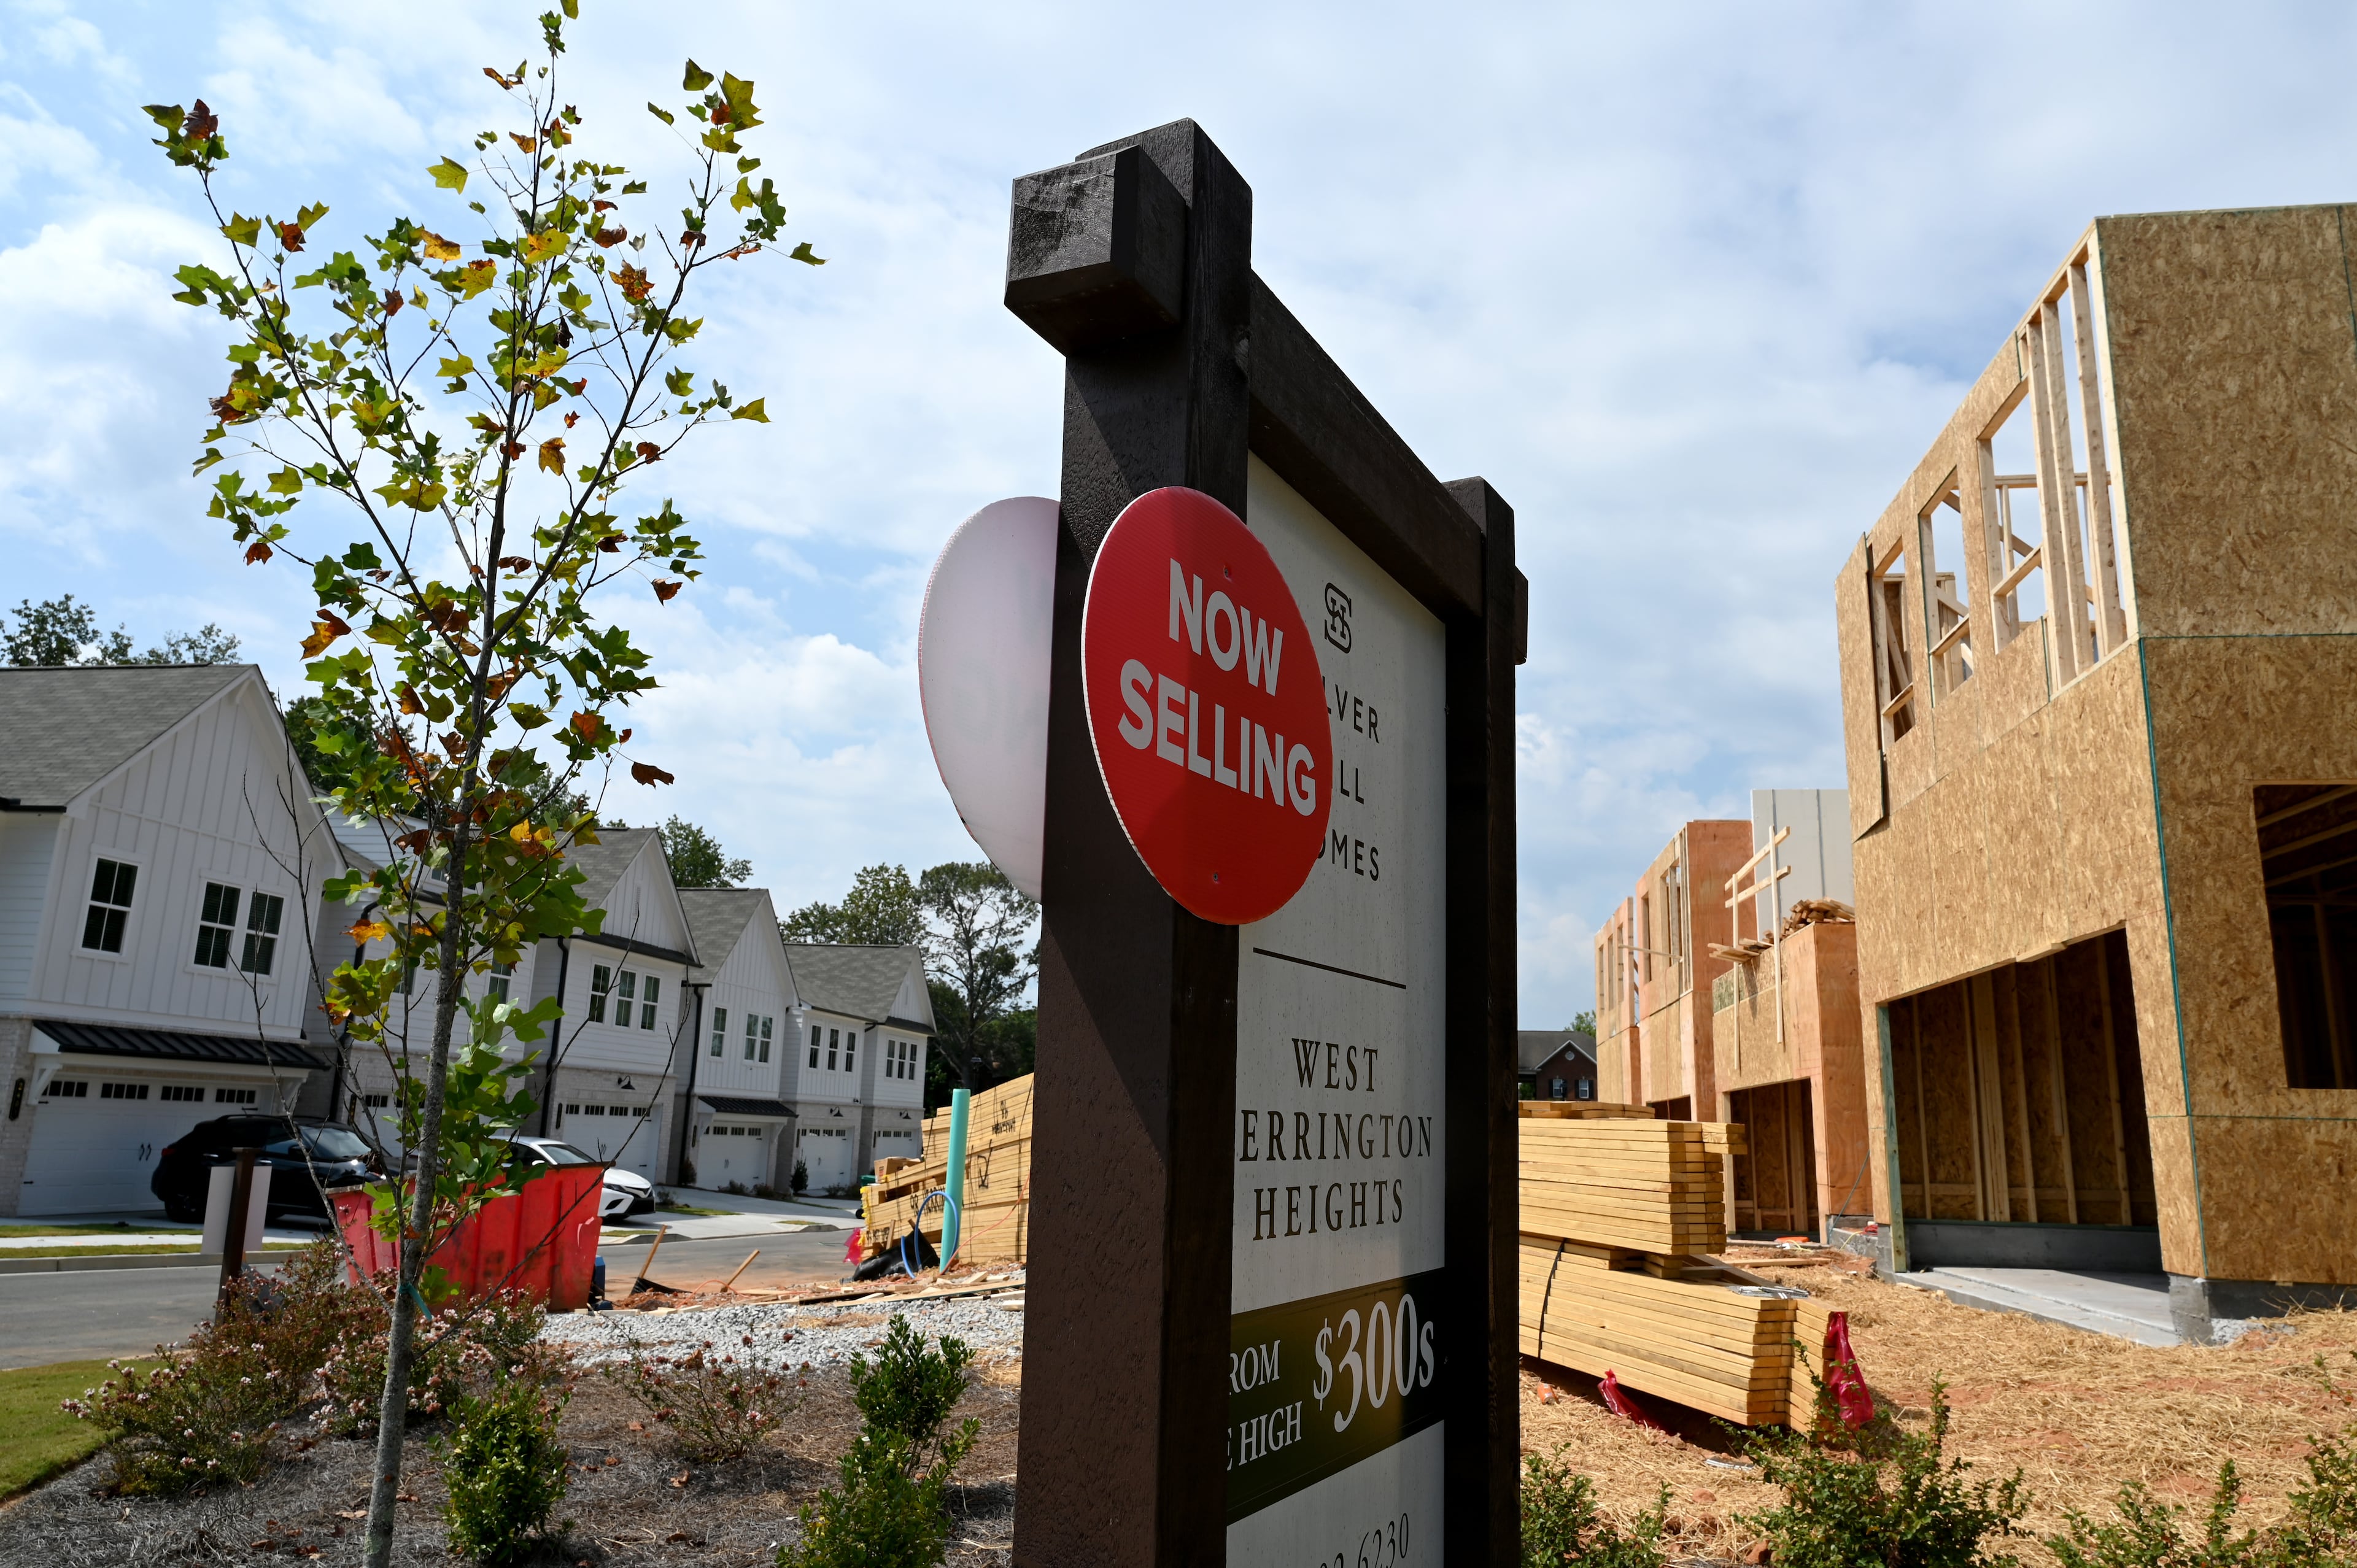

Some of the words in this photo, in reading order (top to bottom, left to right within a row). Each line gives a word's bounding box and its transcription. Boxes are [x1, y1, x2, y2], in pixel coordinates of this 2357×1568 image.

[1169, 558, 1283, 697] NOW
[1118, 659, 1316, 816] SELLING
[1292, 1038, 1378, 1092] WEST
[1239, 1110, 1433, 1162] ERRINGTON
[1253, 1179, 1403, 1241] HEIGHTS
[1239, 1400, 1302, 1466] HIGH
[1313, 1294, 1434, 1432] $300s
